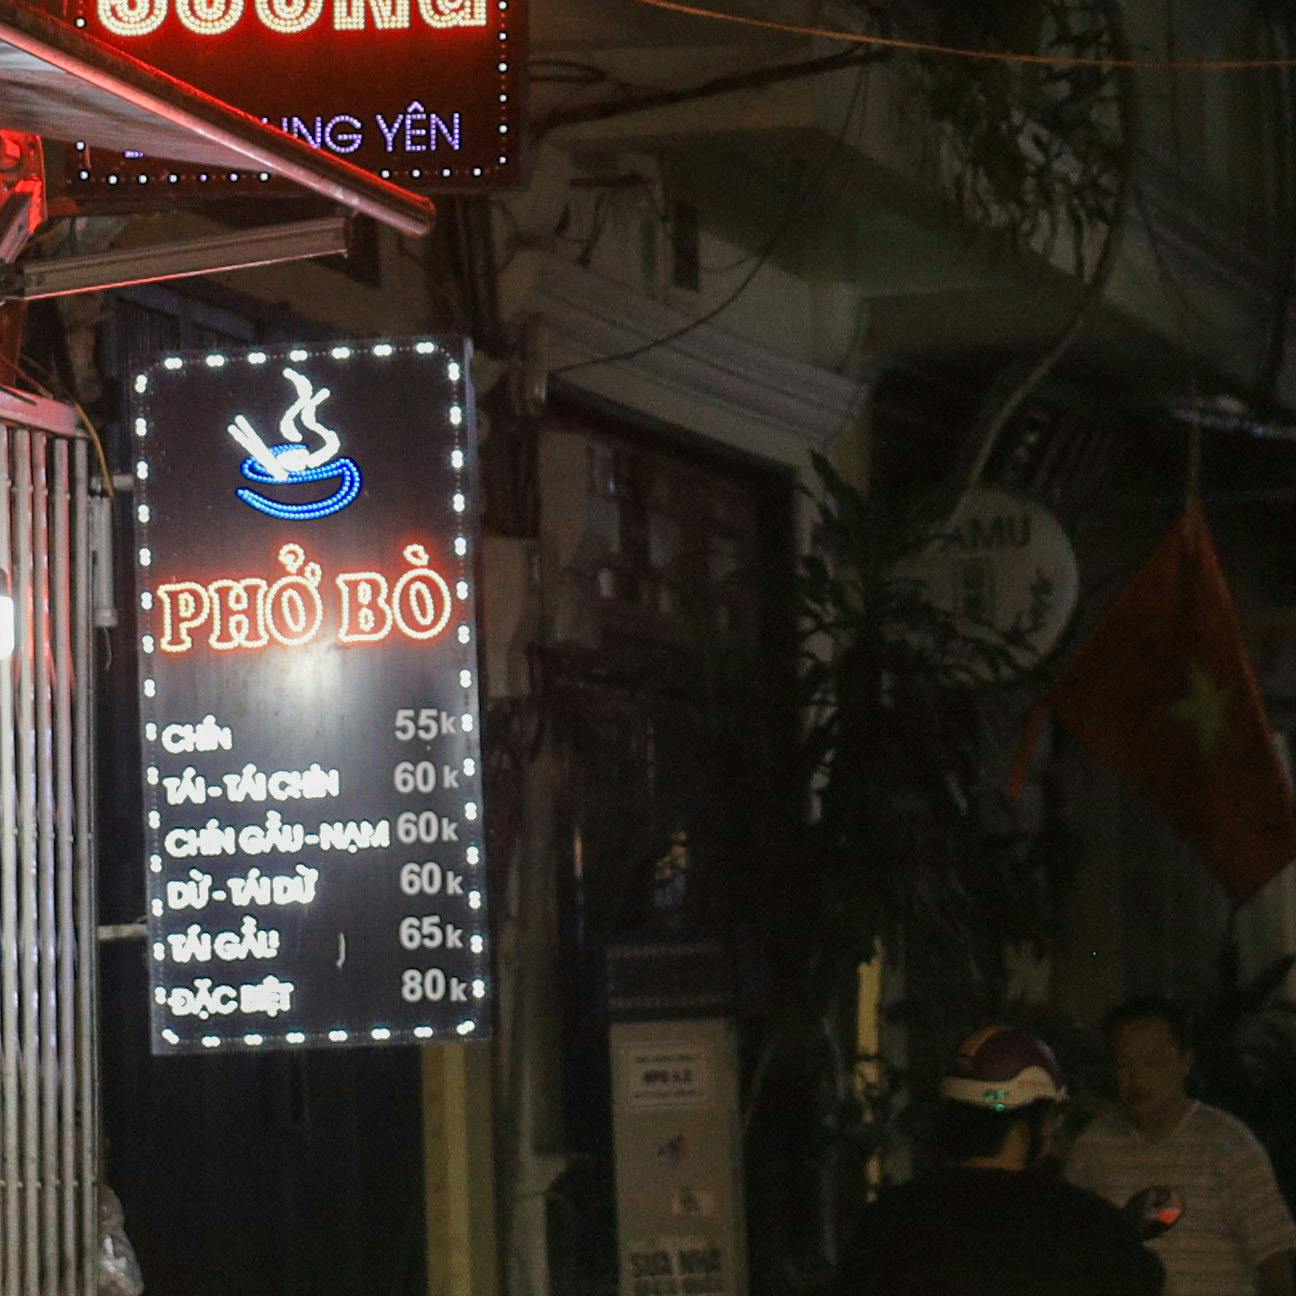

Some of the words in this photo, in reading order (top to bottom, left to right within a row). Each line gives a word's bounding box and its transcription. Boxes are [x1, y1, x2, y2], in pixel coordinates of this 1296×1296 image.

[374, 100, 461, 154] YÊN
[156, 542, 324, 652] PHỞ
[336, 543, 452, 643] BÒ
[161, 714, 233, 753] CHÍN
[394, 708, 457, 742] 55k
